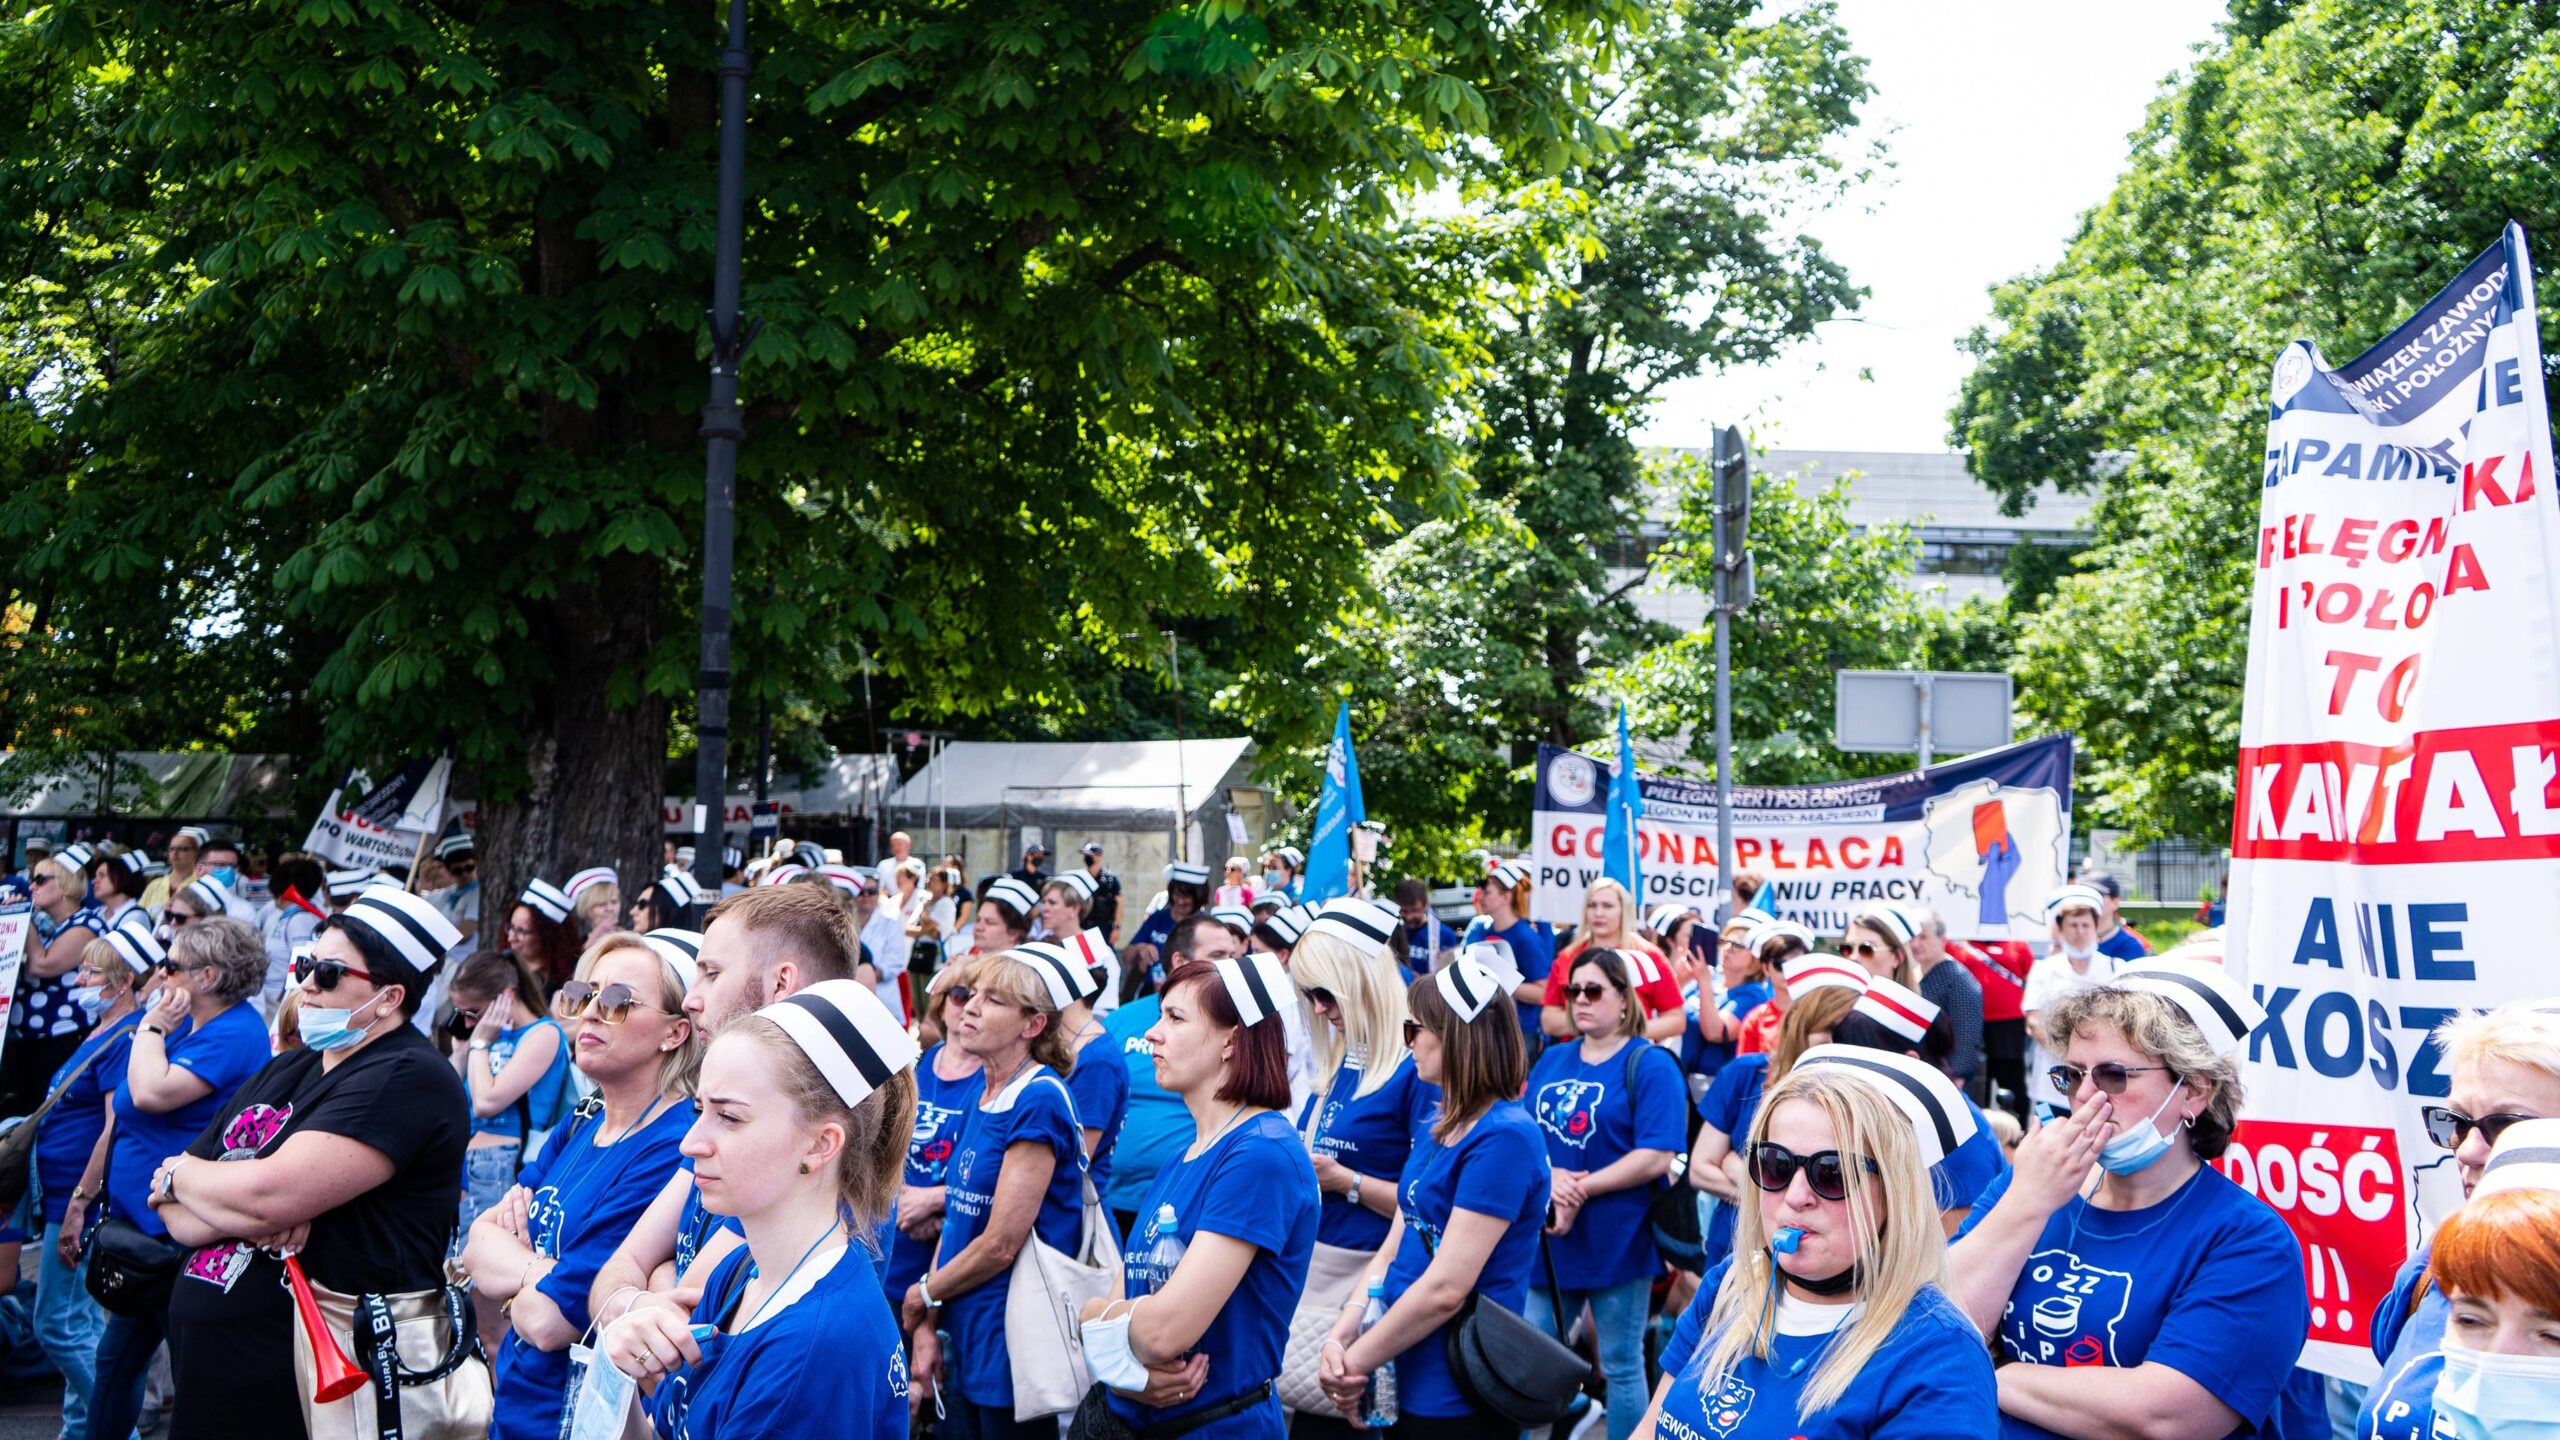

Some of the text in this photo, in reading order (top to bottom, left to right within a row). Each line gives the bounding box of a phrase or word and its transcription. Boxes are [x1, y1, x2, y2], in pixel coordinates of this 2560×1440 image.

[2350, 338, 2431, 396] WIĄZEK
[317, 819, 341, 837] PO
[1735, 836, 1904, 869] PŁACA
[1541, 868, 1570, 887] PO
[2293, 897, 2477, 981] A NIE
[2249, 984, 2466, 1099] KOSZ
